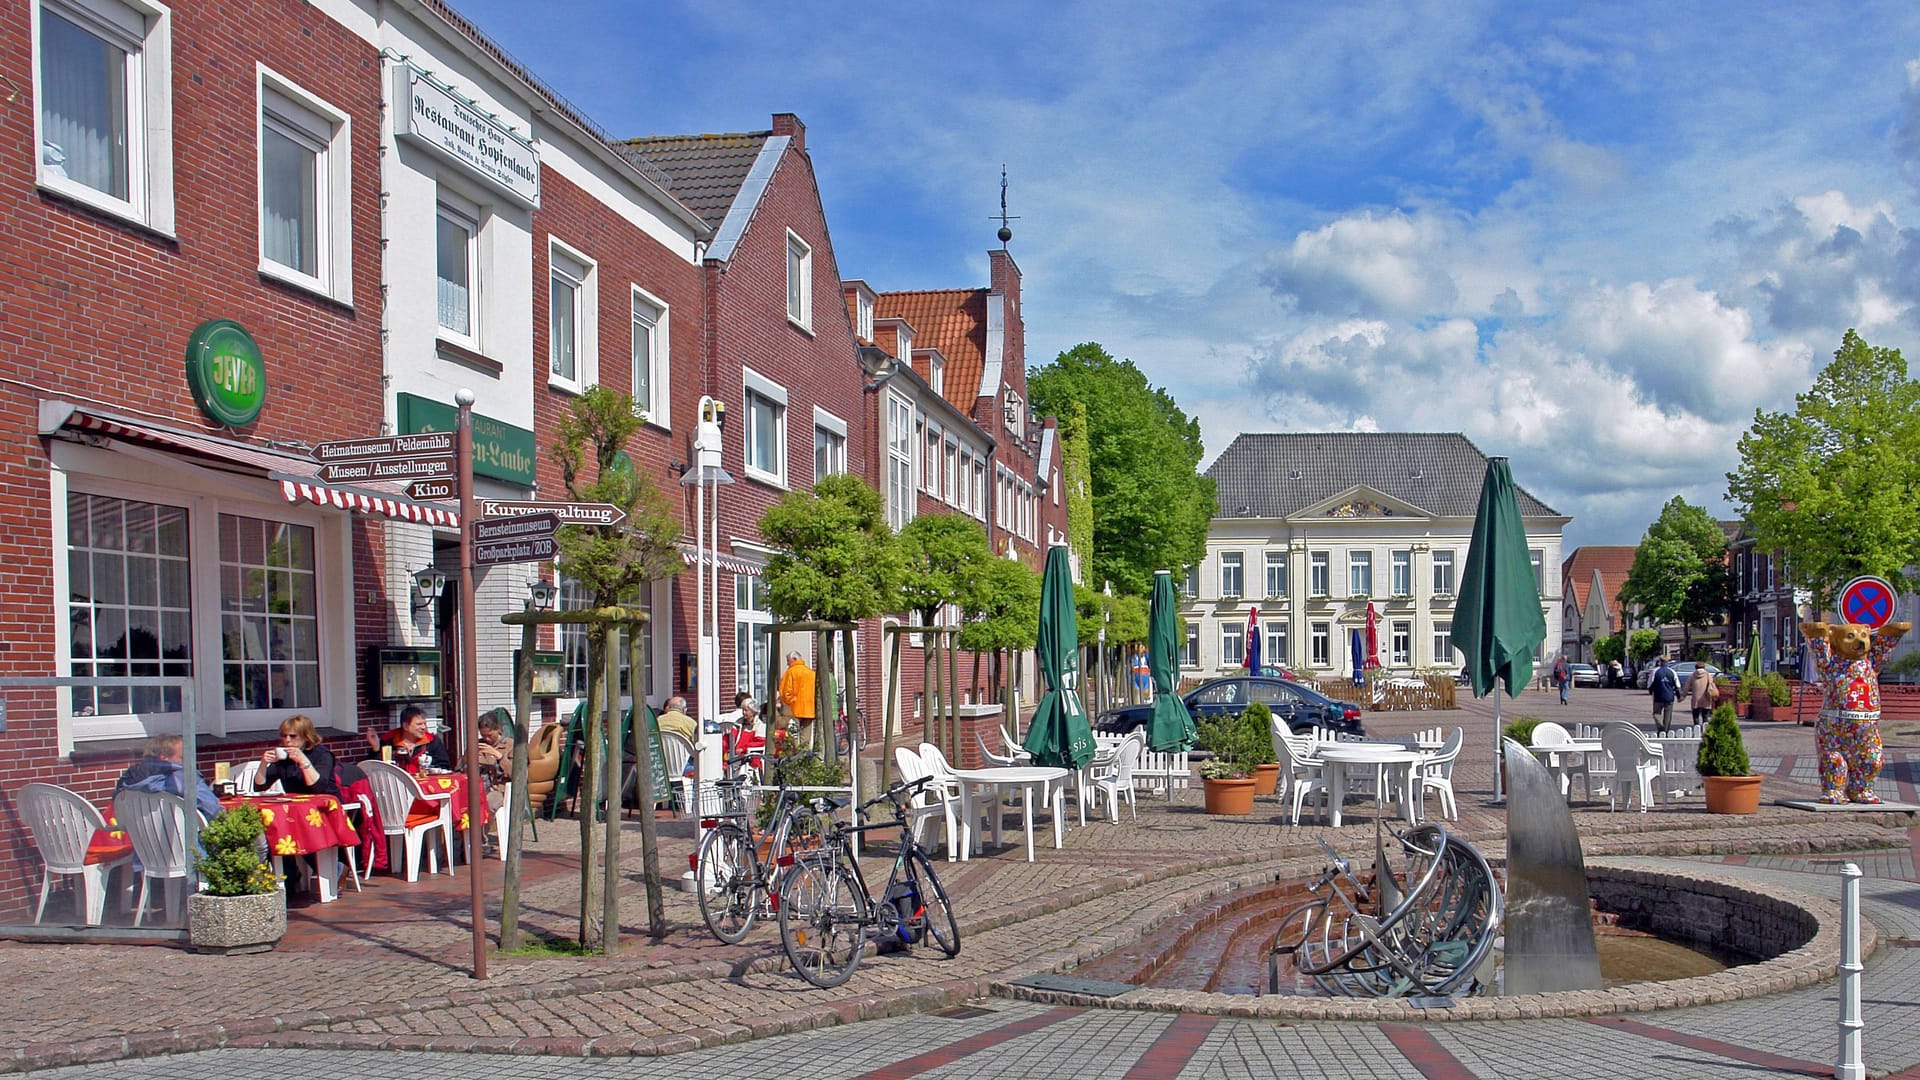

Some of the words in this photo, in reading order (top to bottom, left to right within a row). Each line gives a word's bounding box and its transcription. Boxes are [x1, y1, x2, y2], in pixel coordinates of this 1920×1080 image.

[414, 94, 475, 148] Restaurant
[478, 137, 536, 185] Hopfenlaube
[453, 104, 486, 134] Deutsches
[487, 127, 505, 146] Haus
[213, 355, 256, 395] JEVER
[414, 483, 449, 497] Kino
[484, 502, 613, 522] Kurvealtung
[478, 518, 551, 538] Bernsteinmuseum
